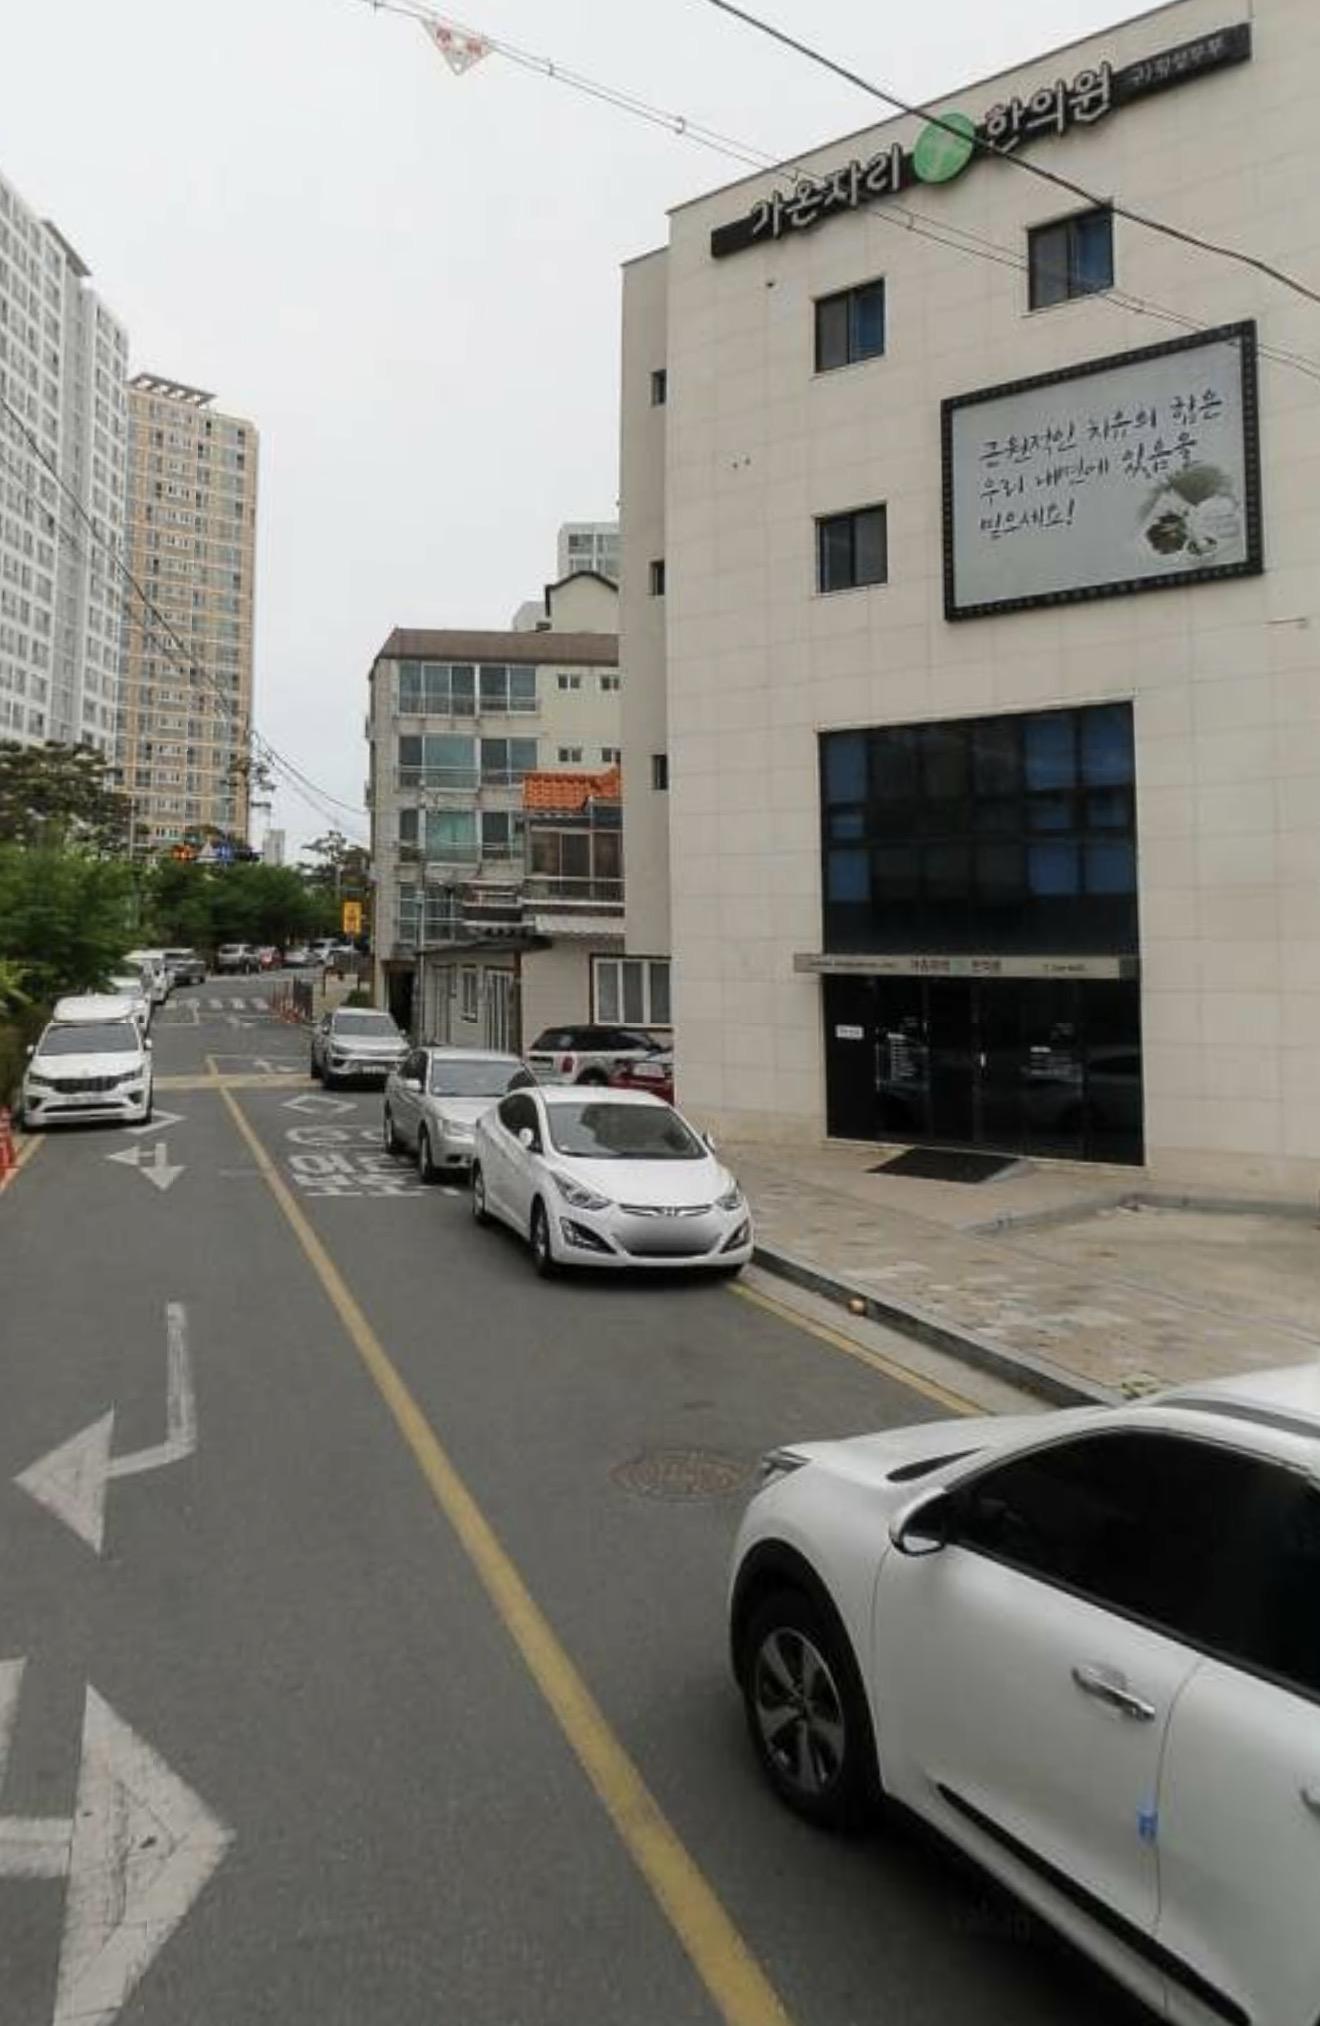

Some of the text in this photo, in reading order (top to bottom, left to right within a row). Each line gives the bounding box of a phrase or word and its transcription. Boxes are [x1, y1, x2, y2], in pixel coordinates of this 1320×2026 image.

[752, 142, 902, 238] 가온자리
[984, 60, 1112, 154] 한의원
[979, 388, 1223, 468] 근원적인 치유의 힘은
[980, 432, 1204, 507] 우리 내면에 있음을
[980, 498, 1076, 541] 믿으세요!
